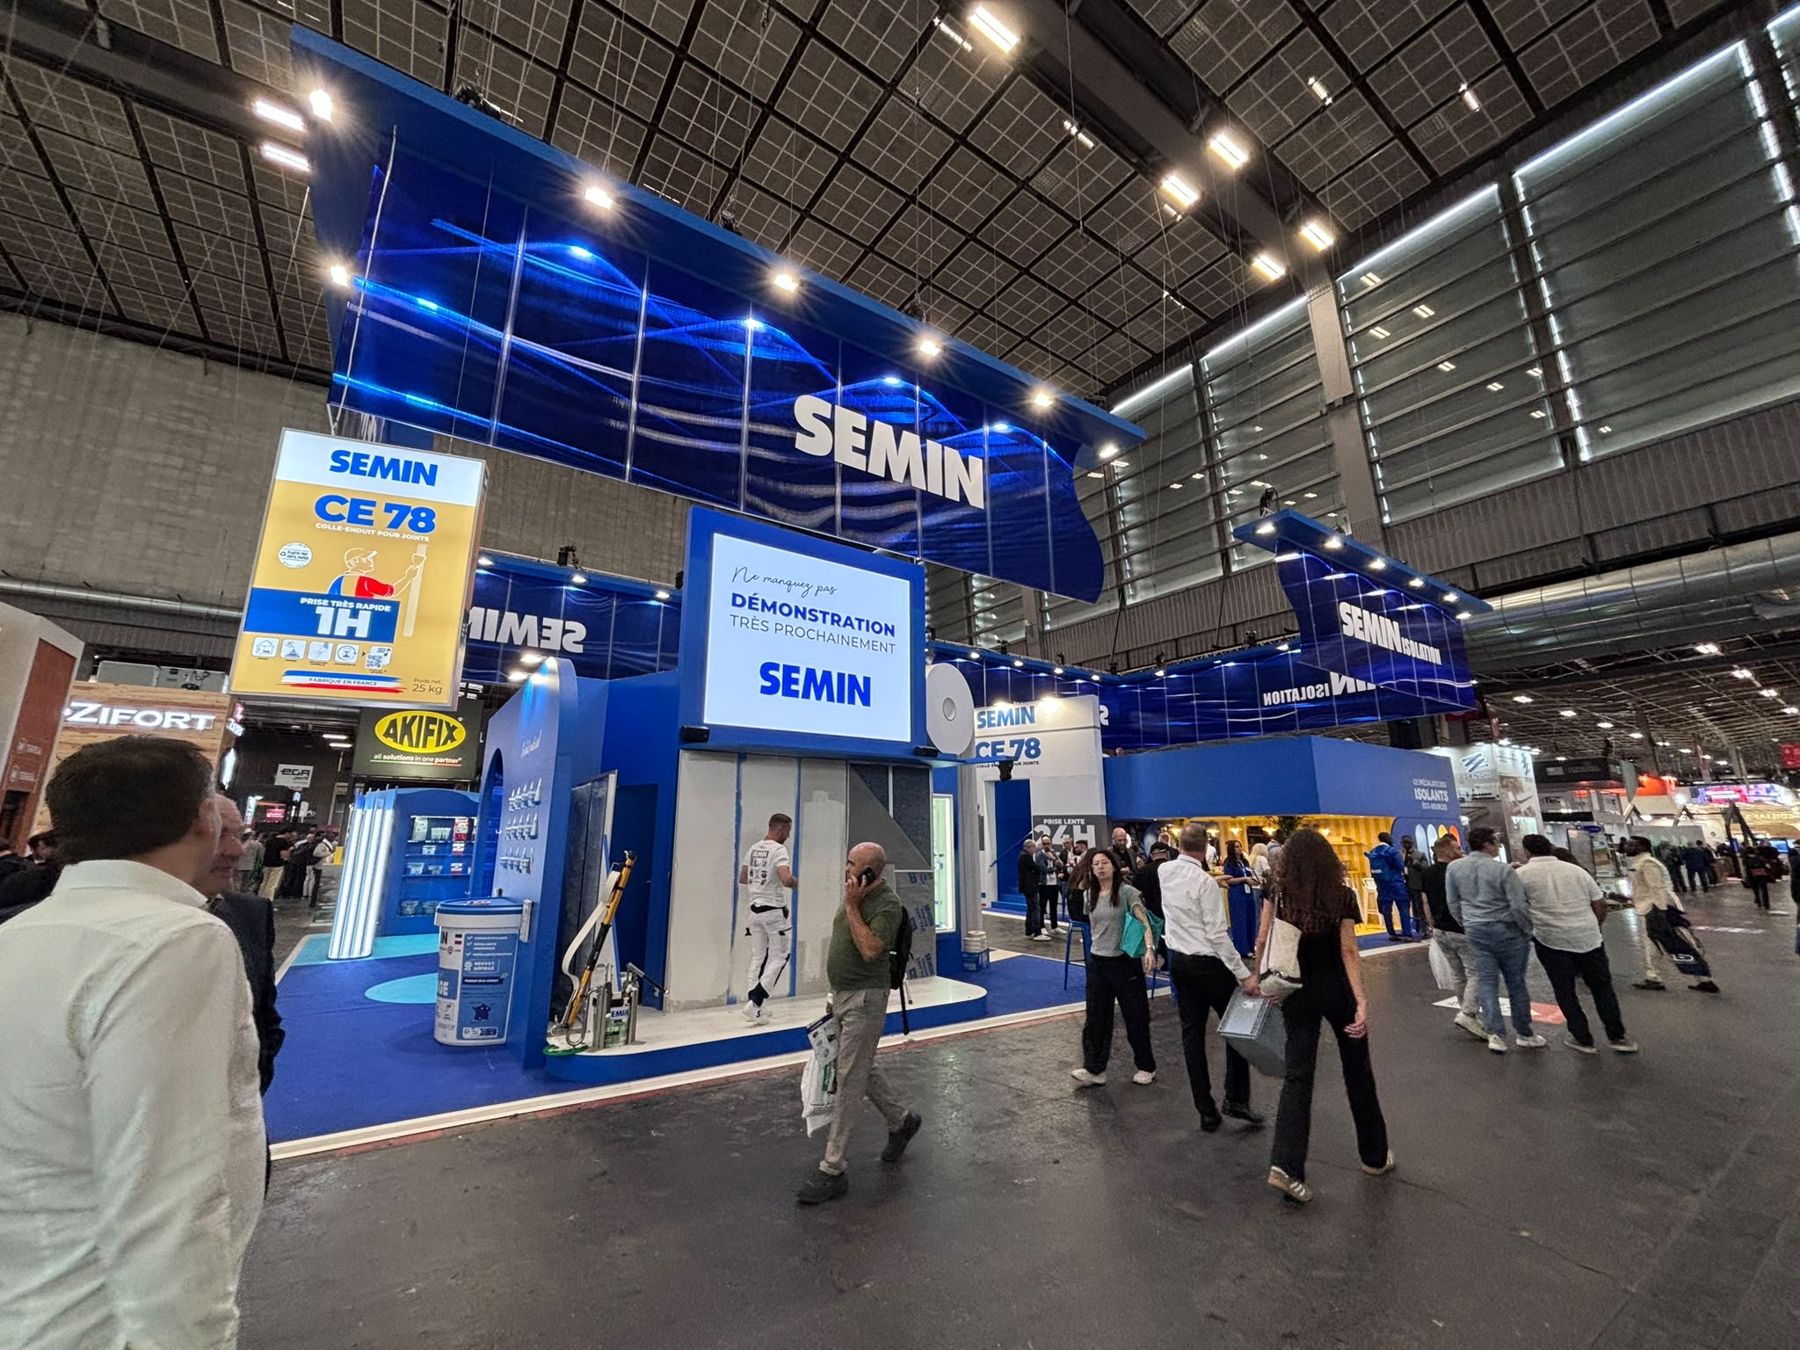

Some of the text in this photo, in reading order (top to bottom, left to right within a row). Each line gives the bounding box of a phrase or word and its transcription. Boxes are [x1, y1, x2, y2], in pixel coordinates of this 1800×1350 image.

[329, 450, 438, 486] SEMIN
[794, 394, 985, 510] SEMIN
[314, 494, 437, 535] CE 78
[315, 522, 430, 542] COLLE-ENDUIT POUR JOINTS
[731, 566, 839, 599] Ne manquez pas
[299, 597, 391, 612] PRISE TRÈS RAPIDE
[731, 592, 896, 638] DÉMONSTRATION
[315, 607, 373, 638] 1H
[729, 613, 897, 655] TRÈS PROCHAINEMENT
[1339, 602, 1403, 653] SEMIN
[1401, 637, 1442, 665] ISOLATION
[412, 684, 443, 696] 25 kg
[759, 661, 872, 708] SEMIN
[64, 701, 217, 730] ZIFORT
[383, 714, 458, 749] AKIFIX
[976, 706, 1035, 729] SEMIN
[1009, 738, 1041, 762] 78
[1414, 788, 1449, 802] ISOLANTS
